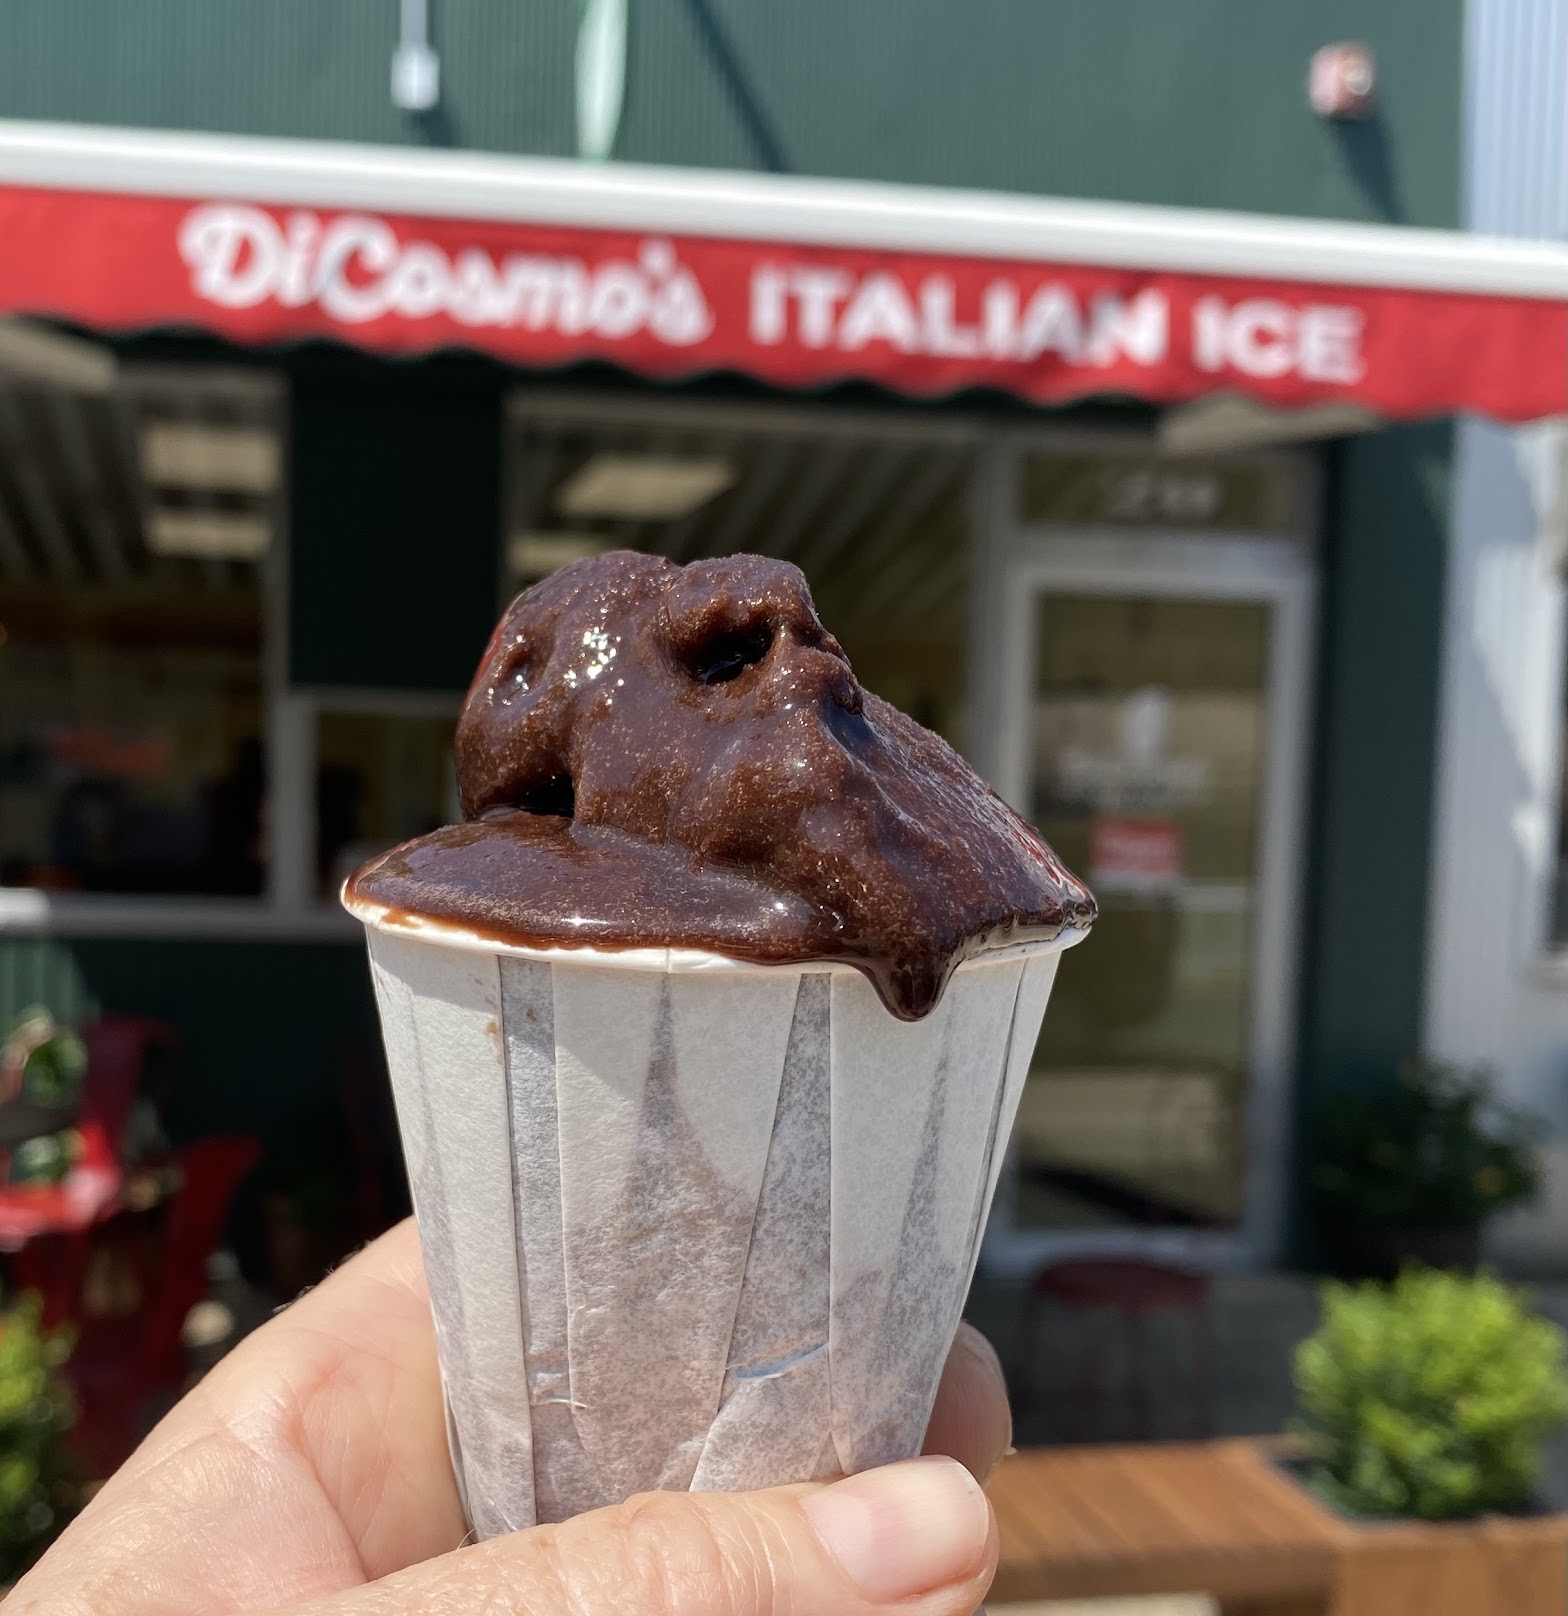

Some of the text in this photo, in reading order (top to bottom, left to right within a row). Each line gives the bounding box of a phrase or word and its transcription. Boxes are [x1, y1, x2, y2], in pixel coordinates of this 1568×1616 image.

[179, 203, 1366, 385] DiCosmo's ITALIAN ICE
